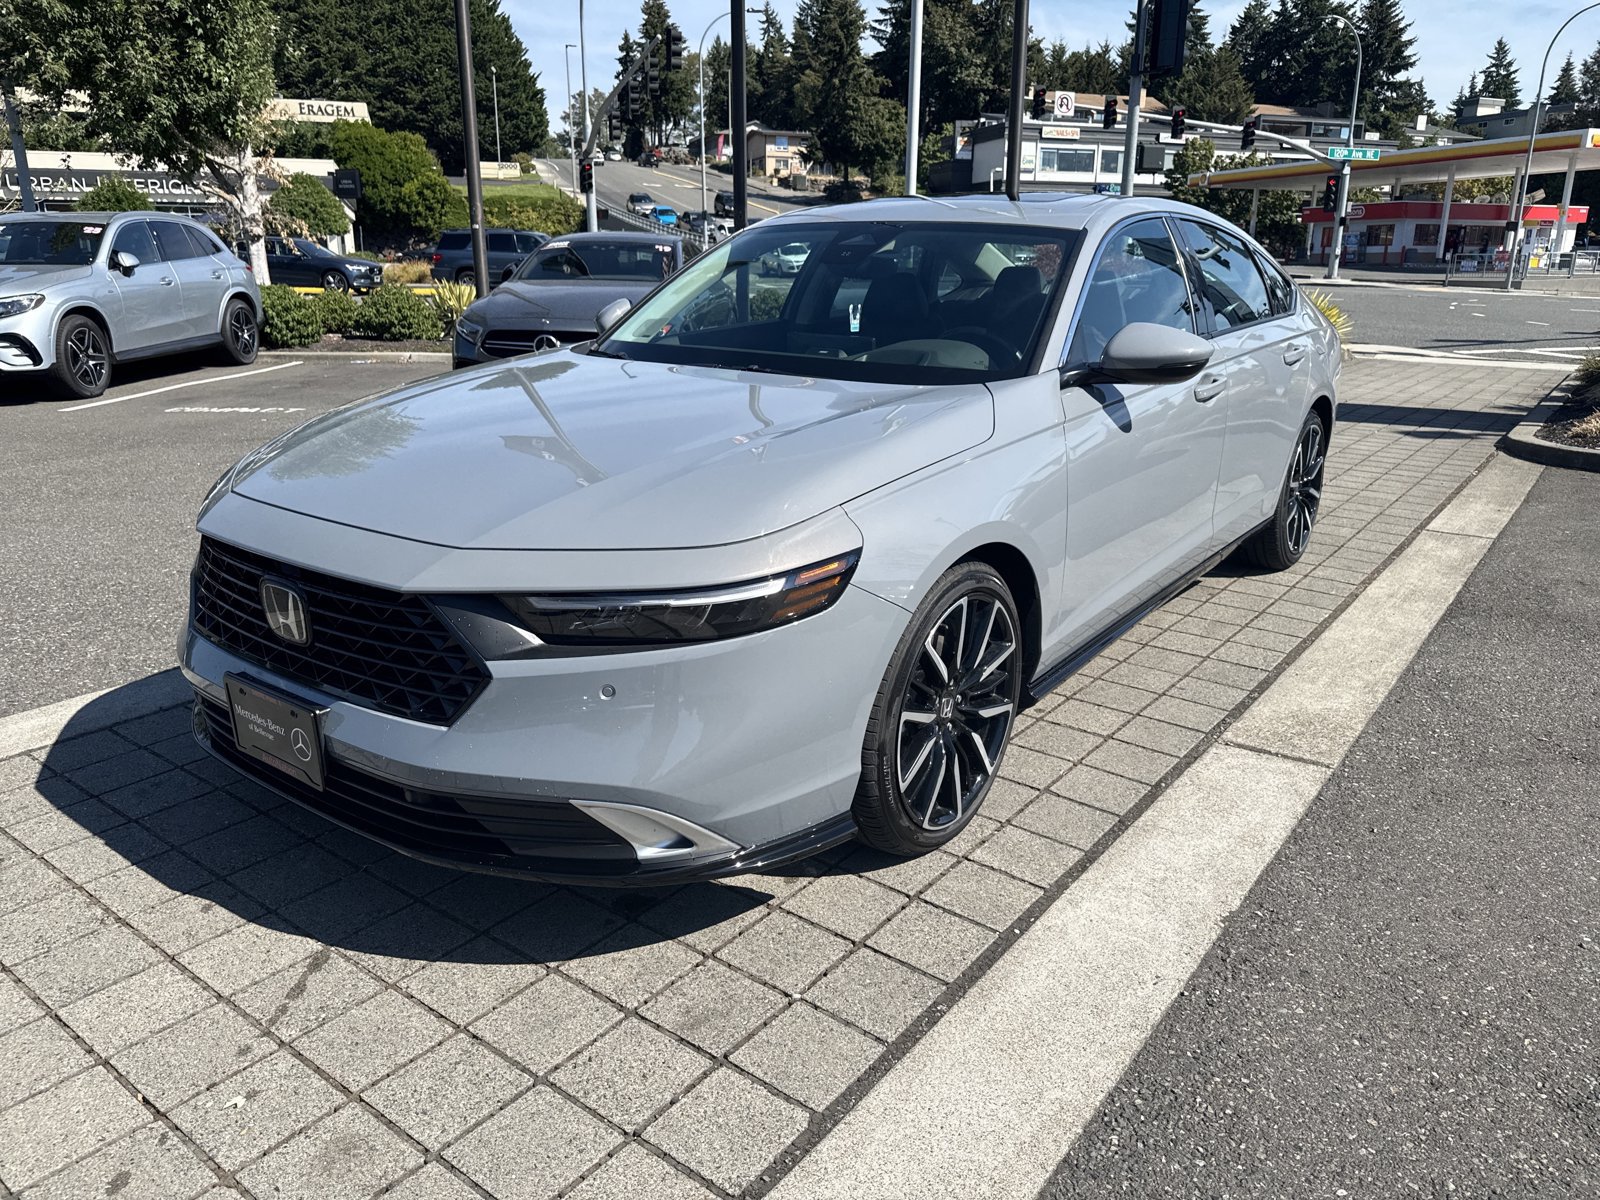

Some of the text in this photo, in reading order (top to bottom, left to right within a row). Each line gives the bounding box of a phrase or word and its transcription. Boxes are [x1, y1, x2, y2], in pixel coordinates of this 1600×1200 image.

[1352, 150, 1362, 158] Ave
[1366, 151, 1375, 159] NE
[235, 703, 285, 736] Mercedes-Benz
